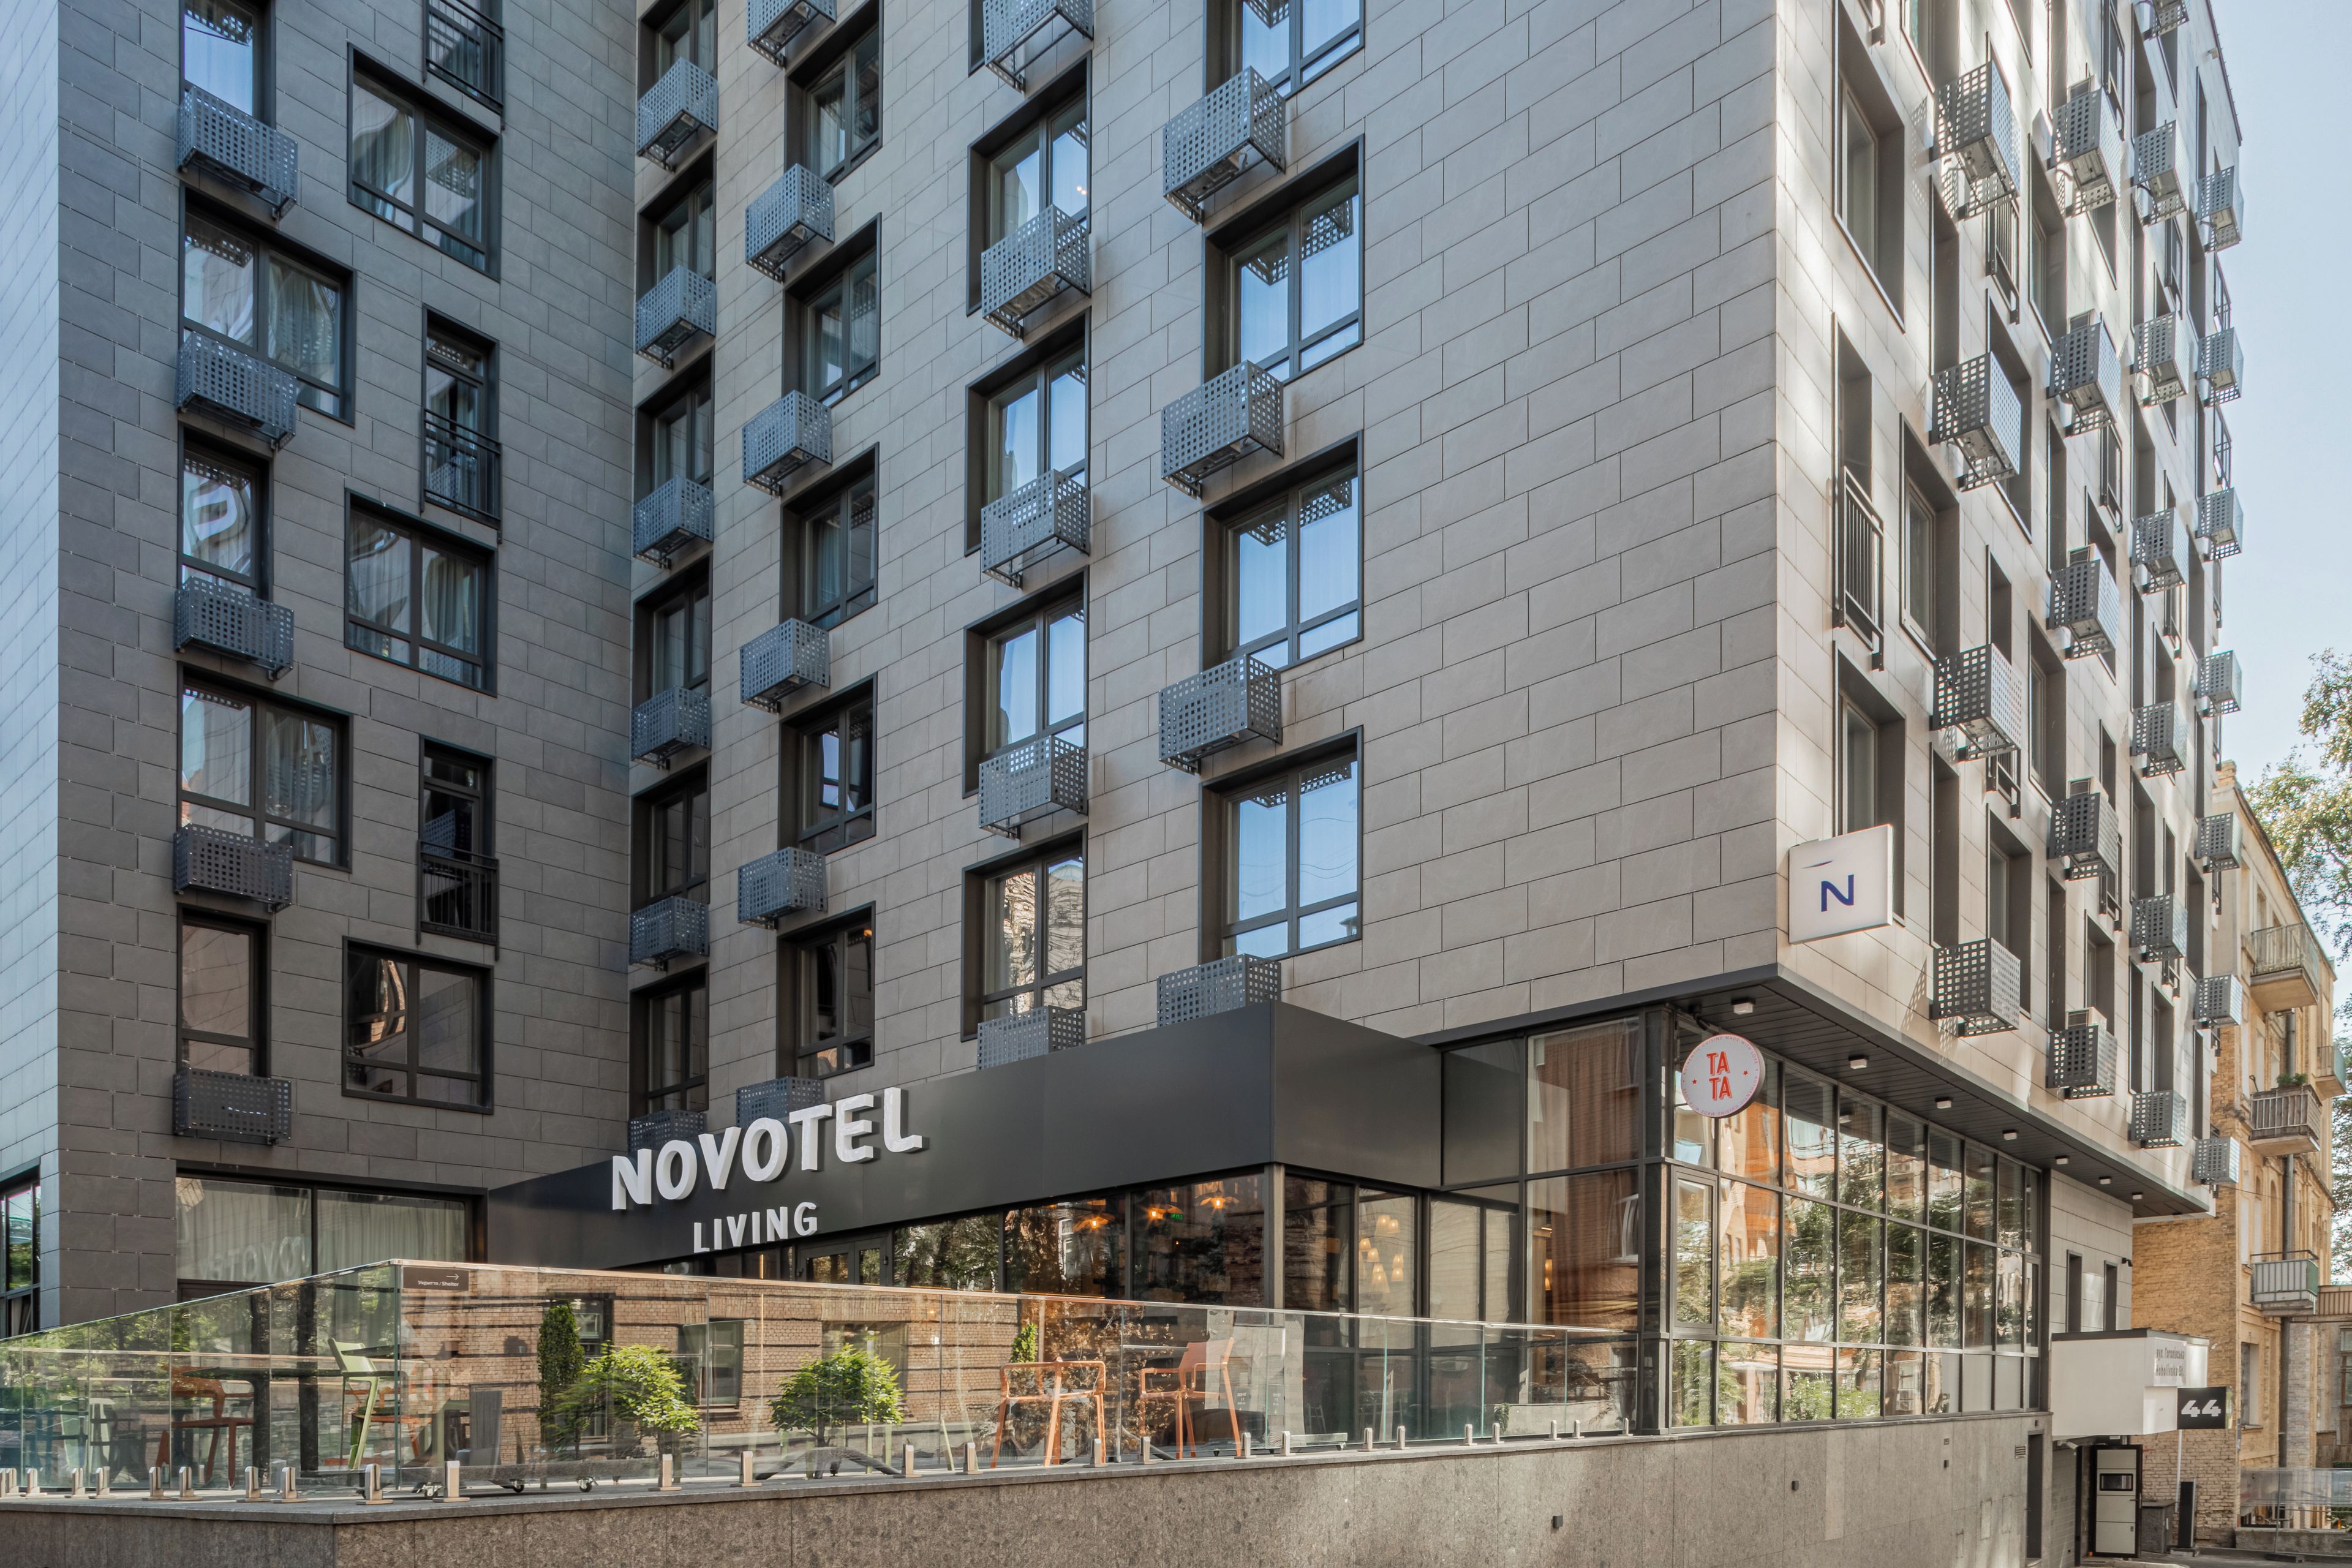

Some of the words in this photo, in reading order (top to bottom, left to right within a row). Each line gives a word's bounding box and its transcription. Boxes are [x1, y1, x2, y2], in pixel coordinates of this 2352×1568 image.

[1821, 874, 1854, 912] N
[1683, 1047, 1701, 1076] AUTHENTIC
[1702, 1036, 1723, 1047] CUISINE
[1741, 1041, 1752, 1050] WITH
[1706, 1051, 1730, 1076] TA
[1709, 1076, 1733, 1101] TA
[612, 1087, 922, 1210] NOVOTEL
[694, 1202, 818, 1253] LIVING
[2181, 1400, 2222, 1417] 44
